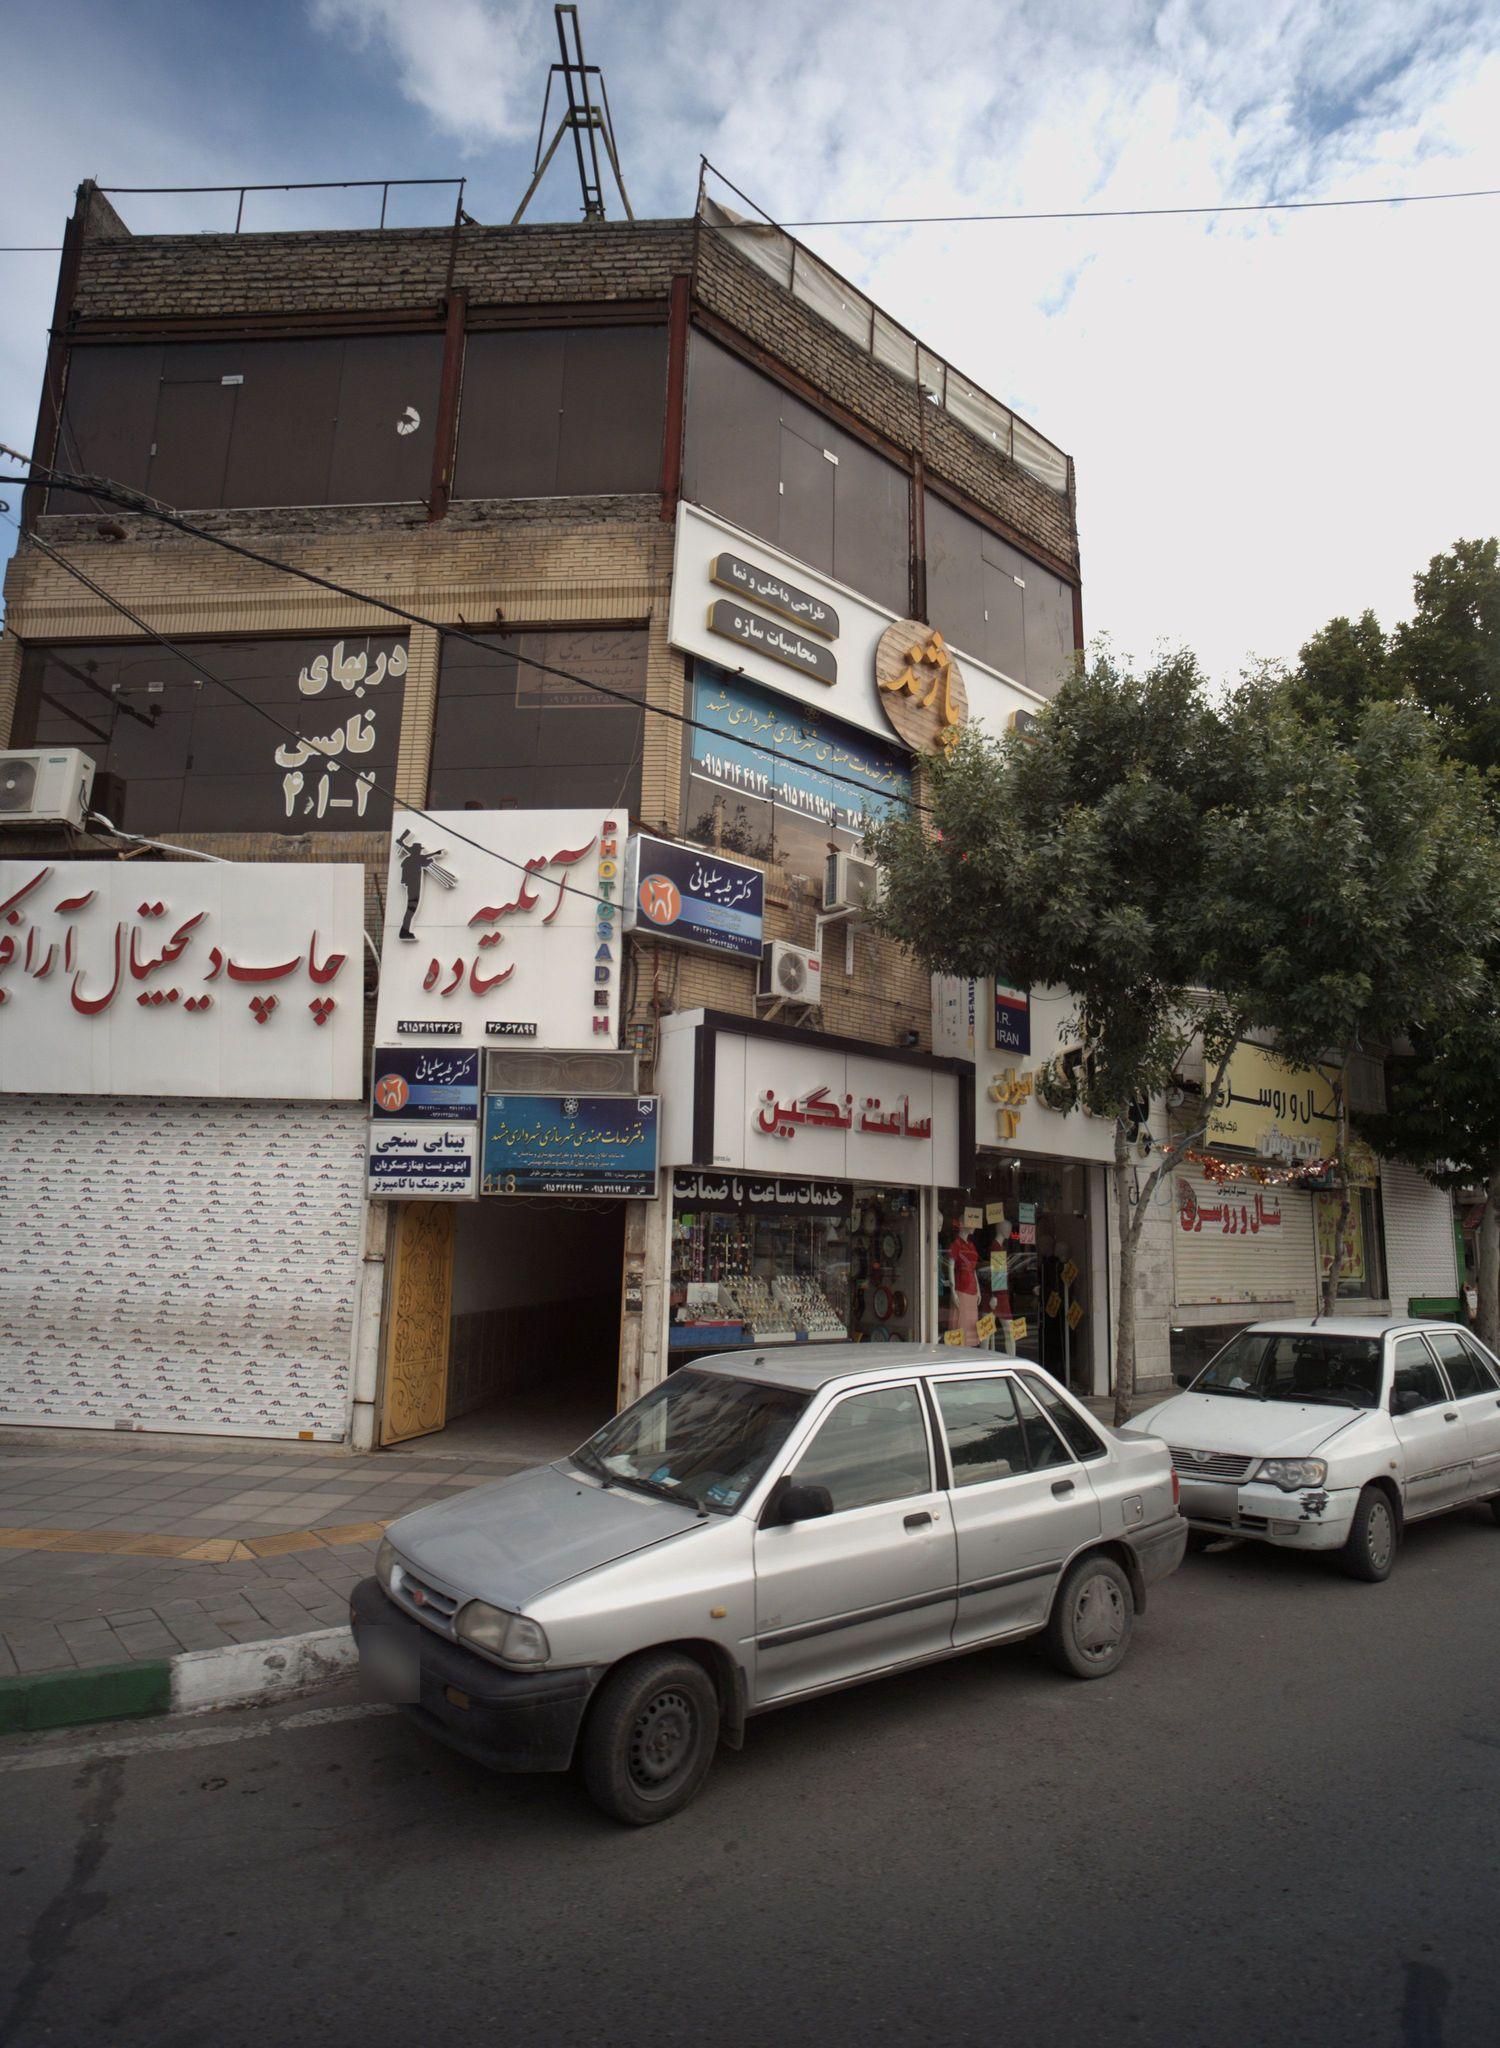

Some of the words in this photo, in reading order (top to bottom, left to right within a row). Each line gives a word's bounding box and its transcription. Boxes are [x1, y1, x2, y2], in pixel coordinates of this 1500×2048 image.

[732, 563, 747, 582] نما
[748, 576, 755, 590] و
[757, 579, 789, 604] داخلی
[790, 595, 826, 621] طراحی
[733, 614, 764, 640] سازه
[766, 629, 818, 665] محاسبات
[704, 690, 731, 711] مشهد
[728, 704, 776, 733] شهرداری
[816, 744, 850, 762] مهندسی
[848, 757, 881, 779] خدمات
[689, 861, 722, 898] سلیمانی
[714, 880, 732, 903] طیبه
[728, 875, 758, 908] دکتر
[70, 900, 226, 1017] دیجیتال
[226, 930, 349, 1026] چاپ
[996, 1011, 1012, 1026] I.R.
[996, 1029, 1020, 1046] IRAN
[415, 1055, 443, 1081] سلیمانی
[437, 1062, 453, 1083] طیبه
[449, 1053, 477, 1085] دکتر
[757, 1086, 853, 1140] نگین
[857, 1095, 932, 1139] ساعت
[1290, 1094, 1297, 1121] و
[376, 1132, 418, 1153] سنجی
[423, 1132, 465, 1153] بینایی
[490, 1121, 509, 1142] مشهد
[506, 1121, 542, 1147] شهرداری
[573, 1127, 603, 1147] مهندسی
[601, 1126, 629, 1145] خدمات
[626, 1121, 646, 1147] دفتر
[374, 1160, 407, 1172] عسکریان
[407, 1160, 424, 1173] بهناز
[425, 1160, 467, 1173] اپتومتریست
[373, 1178, 408, 1192] کامپیوتر
[408, 1179, 415, 1191] با
[417, 1178, 440, 1191] عینک
[442, 1178, 466, 1192] تجویز
[481, 1173, 517, 1194] 418
[673, 1174, 729, 1201] ضمانت
[732, 1177, 744, 1207] با
[749, 1181, 797, 1204] ساعت
[797, 1181, 843, 1206] خدمات
[1179, 1198, 1238, 1234] روسری
[1240, 1206, 1248, 1234] و
[1250, 1192, 1282, 1235] شال
